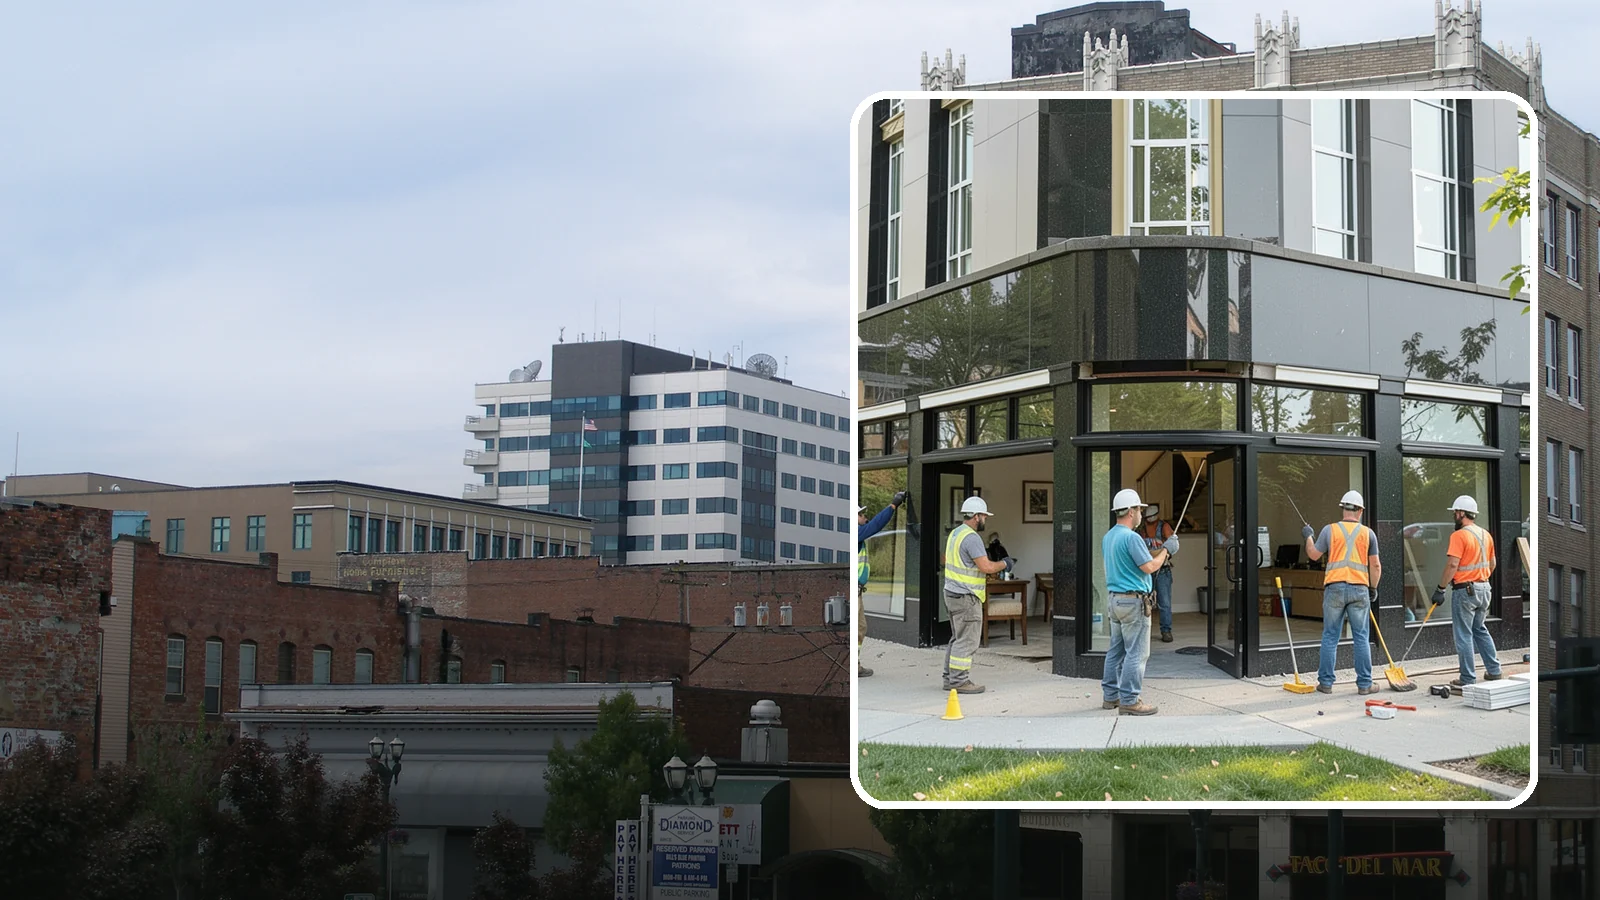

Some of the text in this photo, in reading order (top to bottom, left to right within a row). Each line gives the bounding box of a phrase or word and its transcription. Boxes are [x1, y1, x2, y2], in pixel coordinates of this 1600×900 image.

[362, 556, 406, 567] Complete
[343, 566, 427, 577] Home Furnishers
[660, 817, 713, 832] DIAMOND
[1022, 815, 1070, 827] BUILDING
[656, 845, 716, 854] RESERVED PARKING
[616, 825, 625, 893] PAY HERE
[627, 825, 637, 893] PAY HERE
[722, 851, 739, 862] Soup
[671, 862, 701, 870] PATRONS
[1289, 856, 1442, 877] TAC DEL MAR
[660, 888, 710, 898] PUBLIC PARKING
